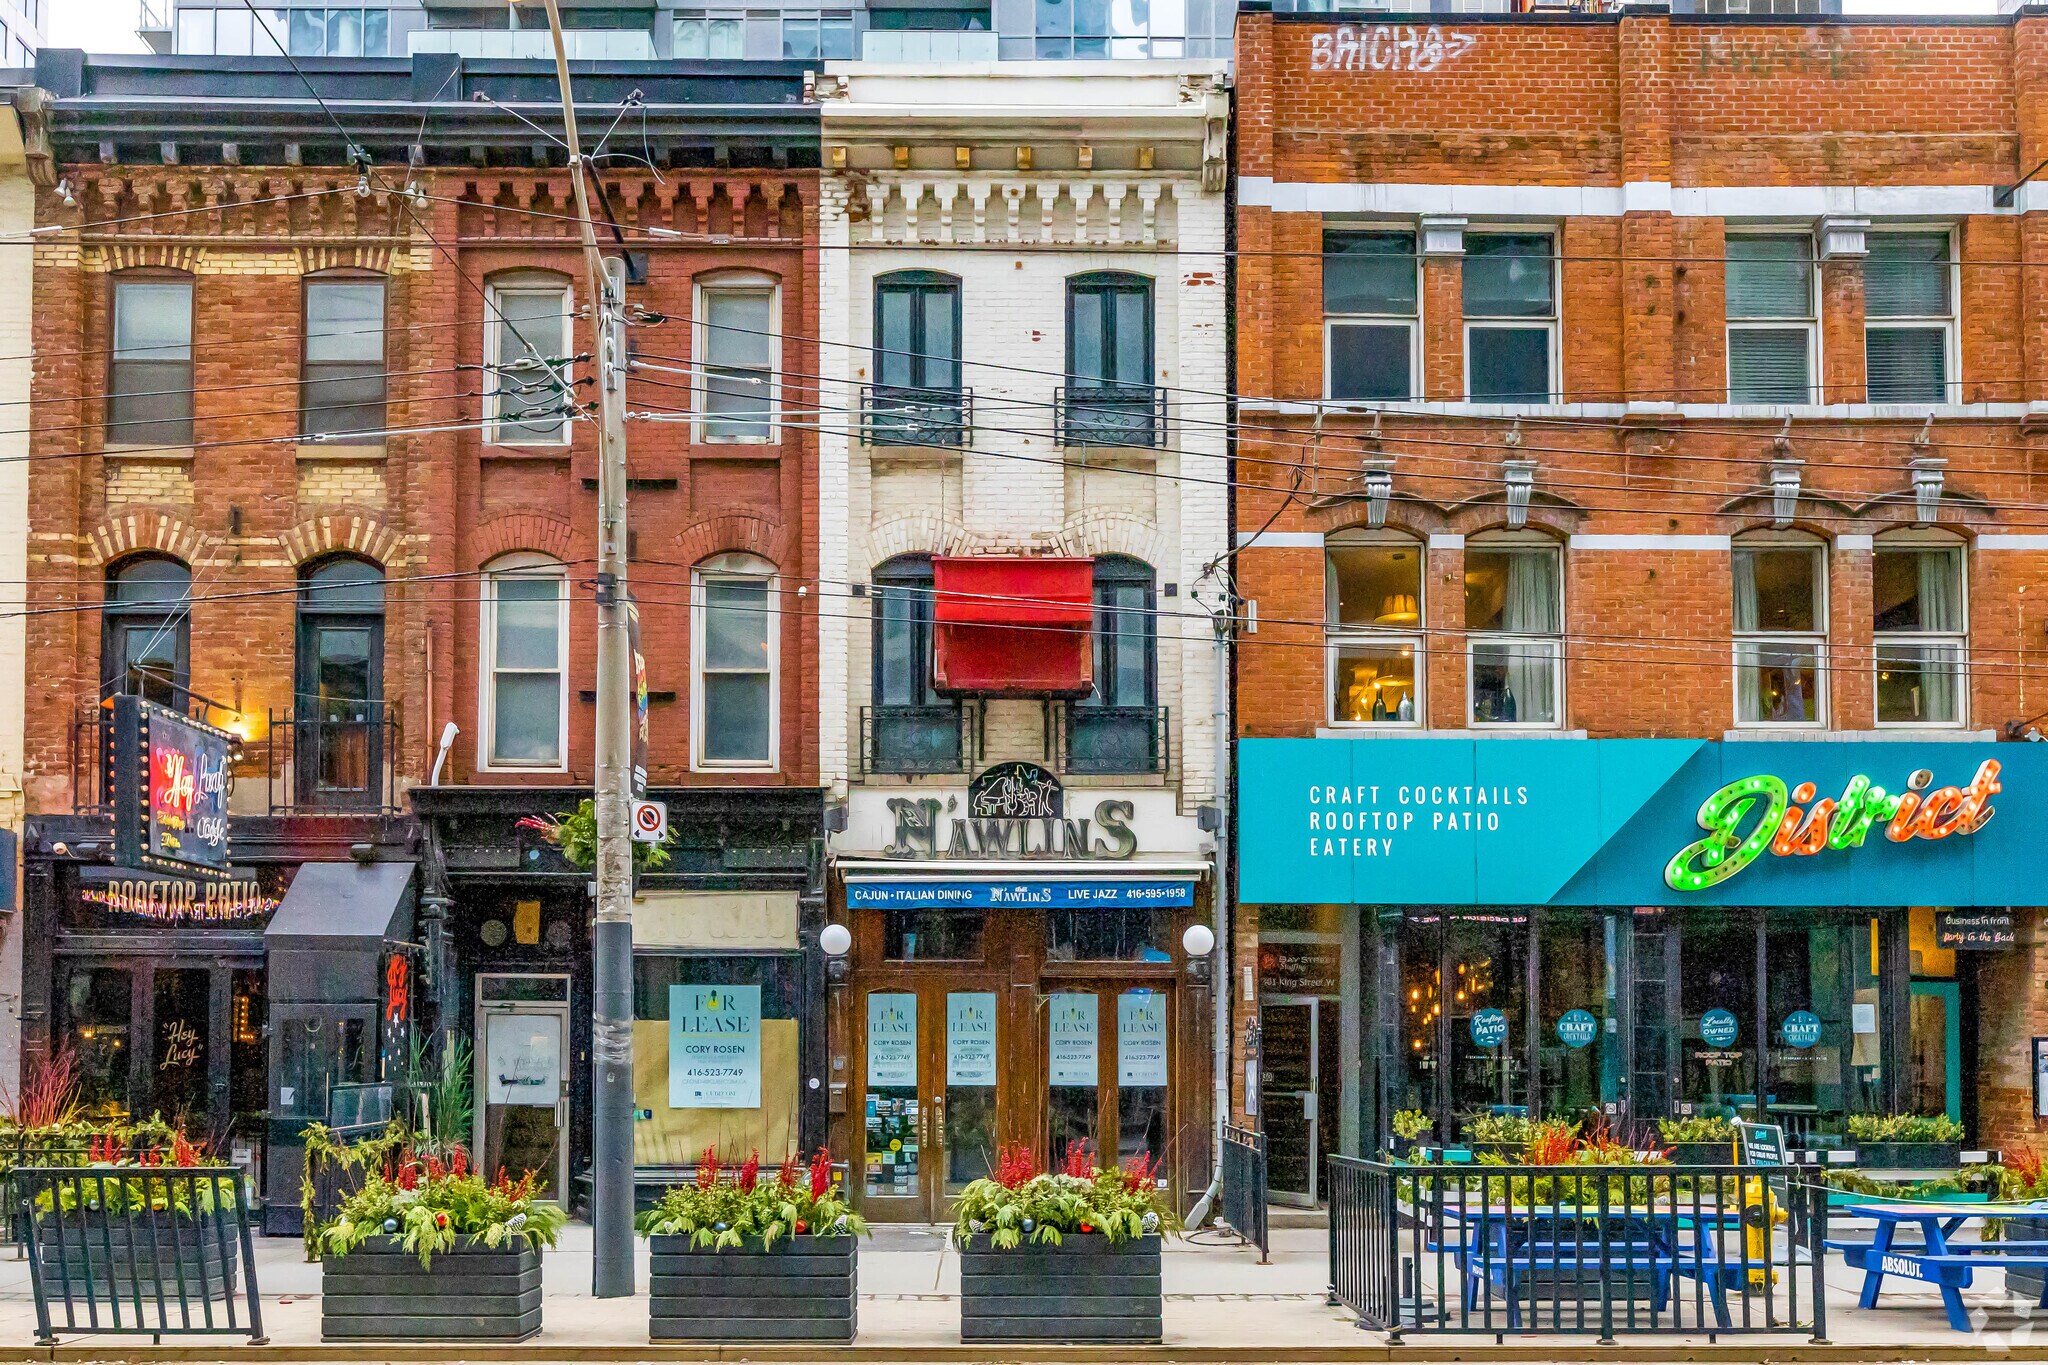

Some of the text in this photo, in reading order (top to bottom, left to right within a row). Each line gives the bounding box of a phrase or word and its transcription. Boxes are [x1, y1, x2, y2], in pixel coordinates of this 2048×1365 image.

[1309, 785, 1528, 805] CRAFT COCKTAILS
[1309, 812, 1499, 831] ROOFTOP PATIO
[1664, 758, 2002, 891] District
[1310, 838, 1393, 856] EATERY
[108, 880, 197, 913] ROOFTOP
[854, 890, 889, 900] CAJUN
[896, 889, 934, 900] ITALIAN
[937, 889, 972, 900] DINING
[1068, 889, 1090, 899] LIVE
[1092, 888, 1118, 899] JAZZ
[682, 1016, 750, 1033] LEASE
[873, 1022, 913, 1033] LEASE
[952, 1022, 992, 1032] LEASE
[1055, 1022, 1093, 1033] LEASE
[1123, 1022, 1162, 1033] LEASE
[1476, 1024, 1505, 1035] PATIO
[1560, 1023, 1593, 1032] CRAFT
[1784, 1024, 1818, 1033] CRAFT
[1703, 1027, 1735, 1035] OWNED
[685, 1045, 745, 1054] CORY ROSEN
[687, 1068, 744, 1077] 416-523-7749
